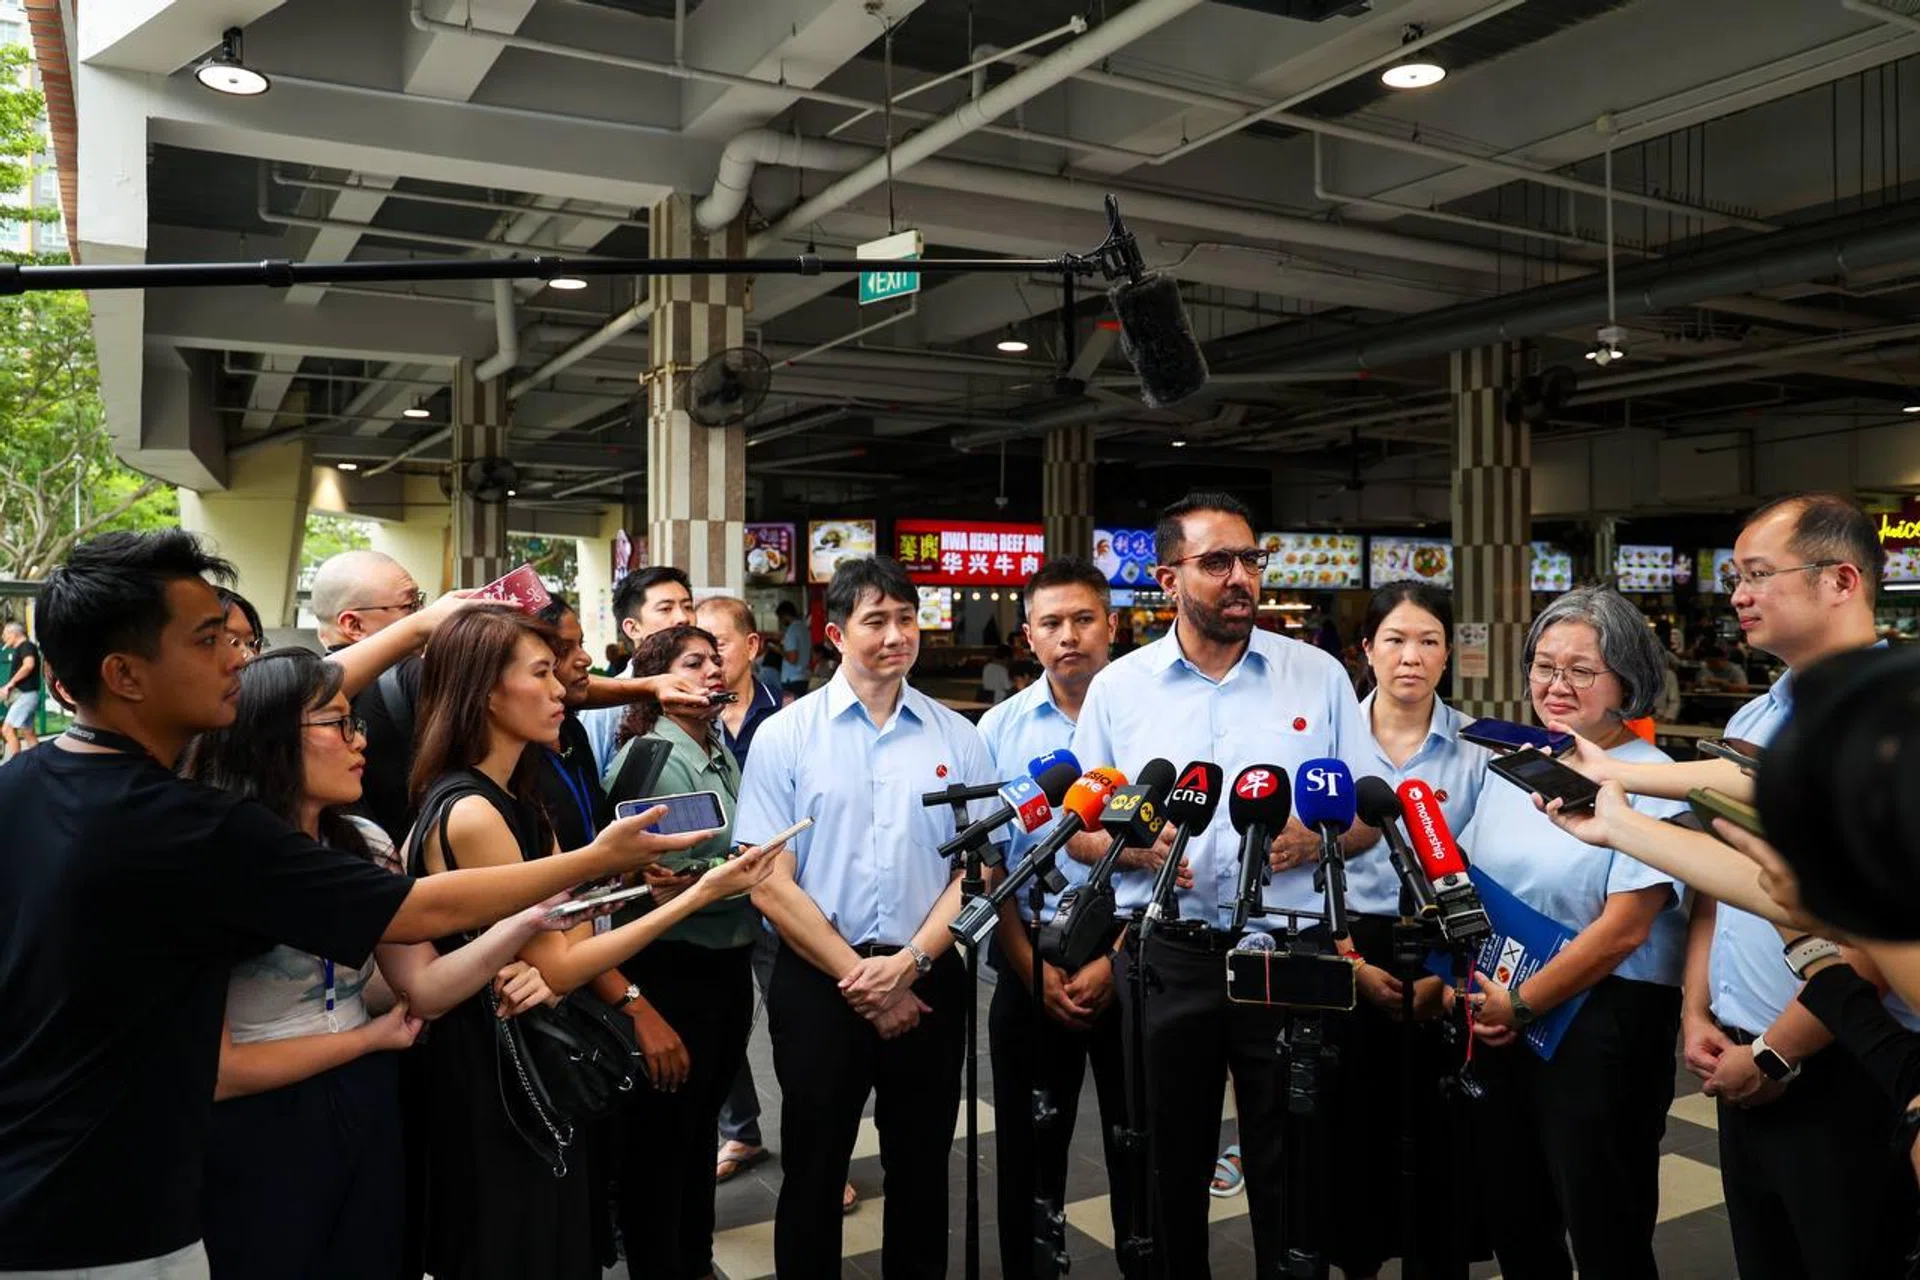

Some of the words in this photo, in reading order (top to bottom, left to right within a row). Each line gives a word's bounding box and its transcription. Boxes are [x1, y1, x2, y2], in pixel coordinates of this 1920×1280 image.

[941, 531, 968, 551] HWA
[969, 532, 998, 552] HENG
[999, 533, 1024, 552] BEEF
[1306, 768, 1342, 797] ST
[1172, 788, 1208, 805] cna
[1416, 802, 1445, 860] mothership
